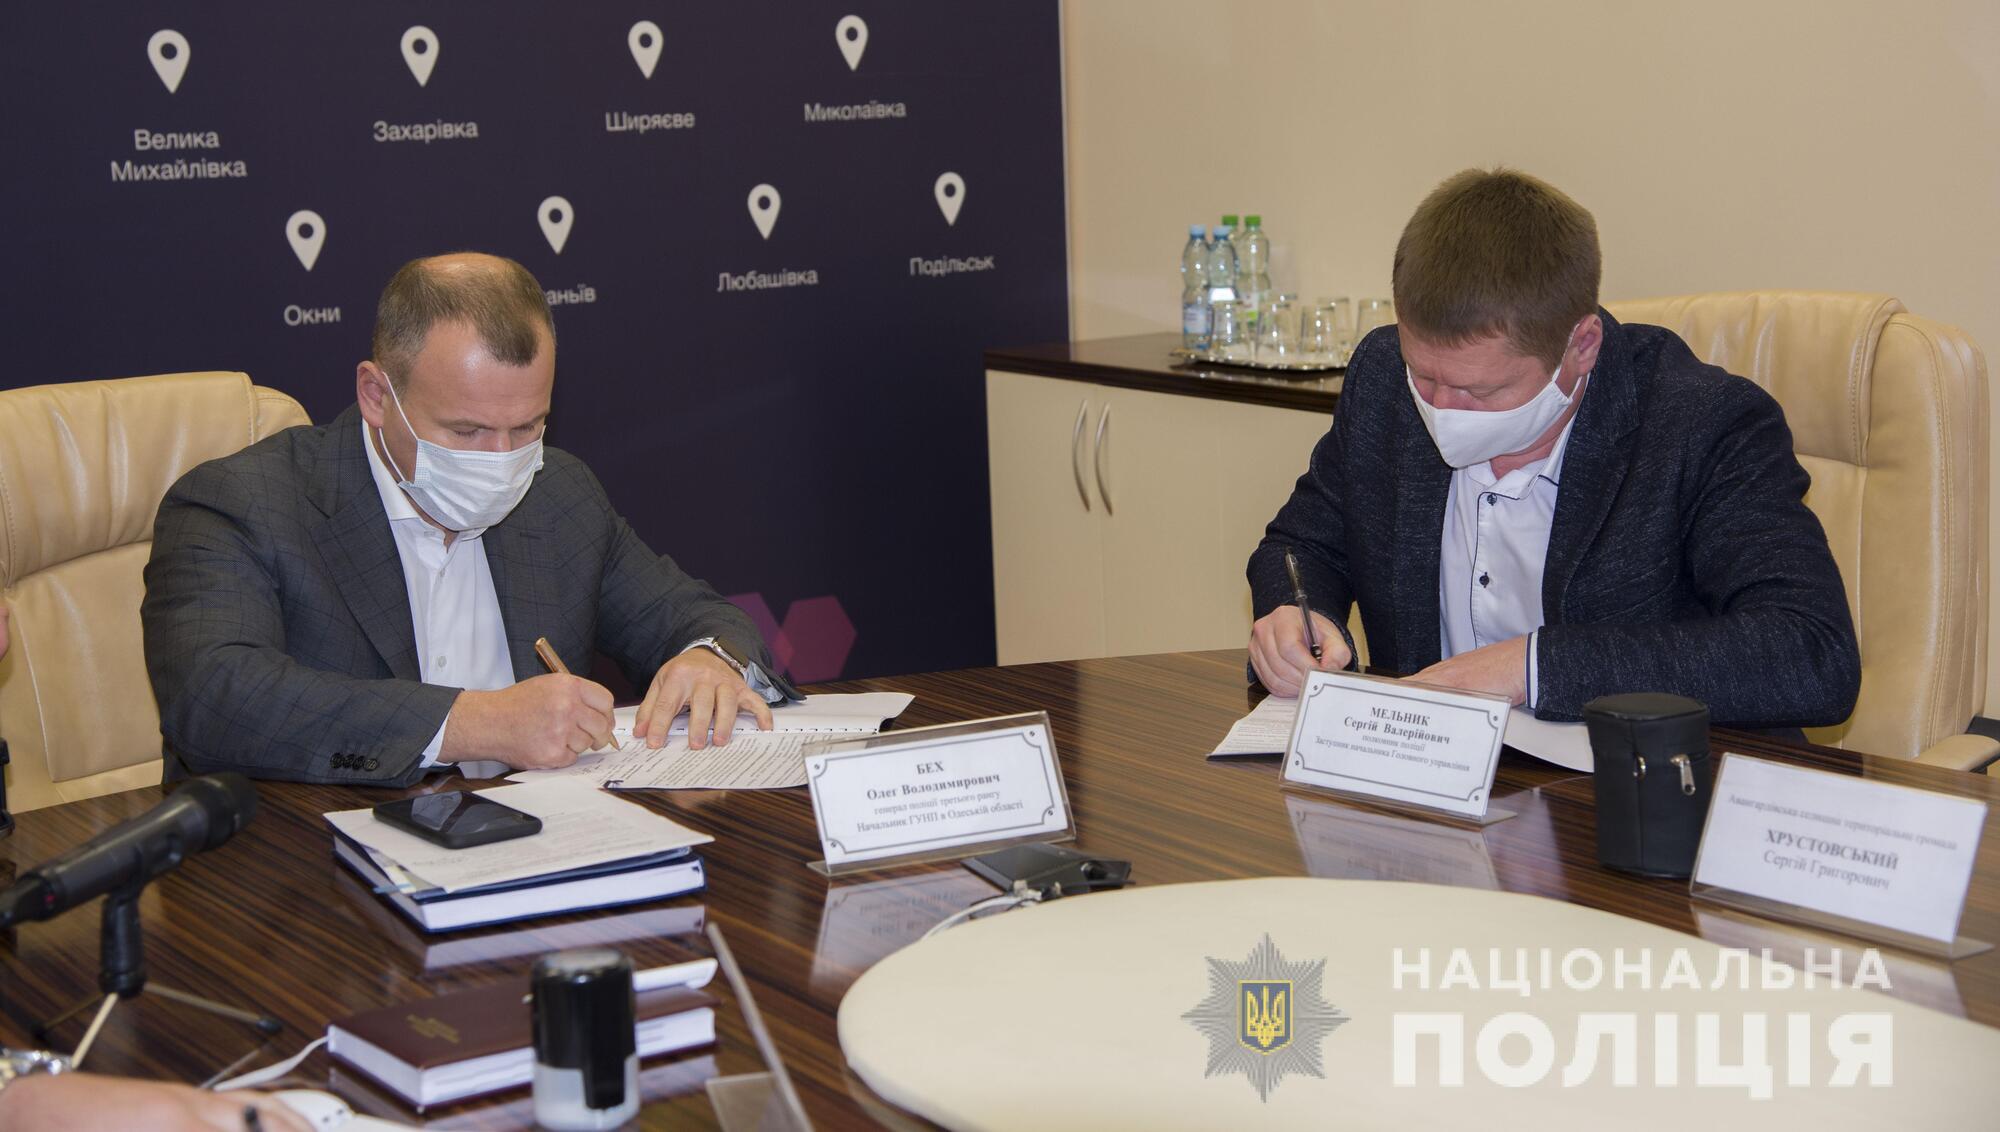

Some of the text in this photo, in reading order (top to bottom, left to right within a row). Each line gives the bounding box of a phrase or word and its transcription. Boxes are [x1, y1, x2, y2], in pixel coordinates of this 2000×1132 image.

[605, 110, 696, 134] Ширяєве
[804, 100, 907, 122] Миколаївка
[134, 128, 220, 151] Велика
[372, 118, 479, 145] Захарівка
[111, 156, 248, 182] Михайлівка
[910, 254, 995, 277] Подільськ
[717, 267, 819, 293] Любашівка
[544, 283, 597, 306] аньїв
[283, 304, 341, 327] Окни
[1370, 706, 1431, 727] МЕЛЬНИК
[1344, 716, 1451, 745] Сергій Валерійович
[916, 761, 945, 775] БЕХ
[866, 772, 1001, 801] Олег Володимирович
[857, 818, 907, 832] Начальник
[909, 812, 939, 825] ГУНП
[948, 806, 989, 820] Одеській
[991, 800, 1024, 813] області
[874, 804, 907, 815] генерал
[1765, 828, 1899, 870] ХРУСТОВСЬКИЙ
[1763, 849, 1890, 890] Сергій Григорович
